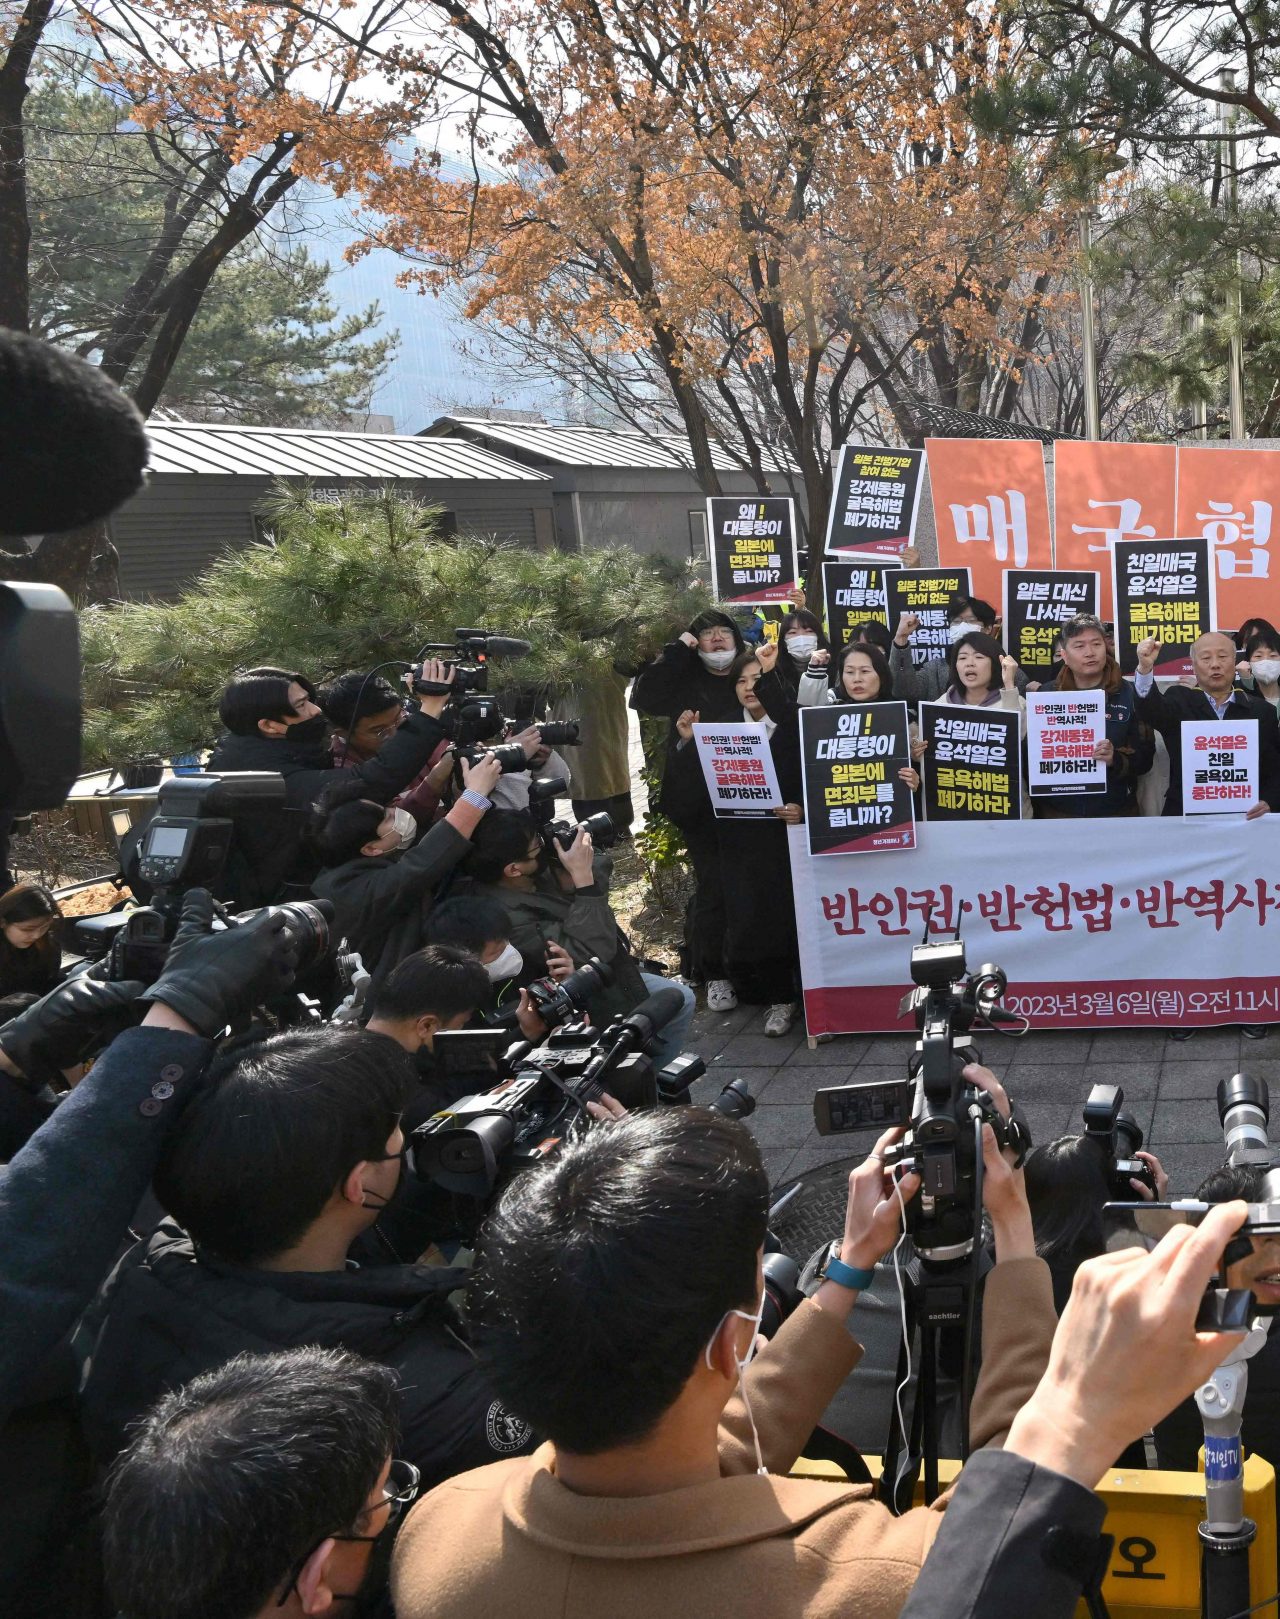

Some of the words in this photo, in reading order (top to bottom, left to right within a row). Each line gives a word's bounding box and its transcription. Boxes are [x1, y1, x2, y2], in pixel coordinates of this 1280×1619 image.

[853, 454, 873, 464] 일본
[874, 455, 911, 467] 전범기업
[860, 465, 880, 476] 참여
[881, 467, 901, 478] 없는
[850, 479, 906, 498] 강제동원
[847, 496, 903, 513] 굴욕해법
[723, 520, 782, 535] 대통령이
[844, 511, 901, 530] 폐기하라
[734, 539, 774, 553] 일본에
[729, 554, 781, 568] 면죄부를
[1127, 552, 1197, 573] 친일매국
[732, 569, 780, 584] 줍니까?
[897, 580, 916, 592] 일본
[918, 579, 959, 591] 전범기업
[1016, 582, 1050, 600] 일본
[1052, 583, 1087, 601] 대신
[1127, 574, 1197, 596] 윤석열은
[907, 593, 927, 605] 참여
[929, 592, 950, 604] 없는
[900, 609, 948, 627] 제동
[1026, 603, 1076, 621] 나서는
[1130, 601, 1200, 622] 굴욕해법
[1130, 624, 1201, 644] 폐기하라
[1035, 704, 1065, 714] 반인권!
[1068, 703, 1098, 713] 반헌법!
[1047, 715, 1086, 725] 반역사적!
[934, 718, 1007, 744] 친일매국
[1041, 729, 1094, 744] 강제동원
[702, 735, 731, 744] 반인권!
[732, 735, 761, 744] 반헌법!
[816, 735, 895, 759] 대통령이
[1194, 735, 1247, 750] 윤석열은
[715, 746, 752, 755] 반역사적!
[934, 741, 1007, 766] 윤석열은
[1041, 744, 1094, 759] 굴욕해법
[712, 759, 764, 772] 강제동원
[1208, 752, 1234, 766] 친일
[831, 762, 885, 784] 일본에
[1039, 760, 1096, 774] 폐기하라!
[716, 773, 767, 786] 굴욕해법
[937, 767, 1009, 793] 굴욕해법
[1194, 769, 1248, 783] 굴욕외교
[717, 787, 773, 799] 폐기하라!
[824, 783, 894, 806] 면죄부를
[1192, 785, 1251, 800] 중단하라!
[937, 789, 1011, 815] 폐기하라
[829, 805, 893, 827] 줍니까?
[1007, 994, 1077, 1017] 2023년
[1080, 992, 1114, 1016] 3월
[1117, 990, 1184, 1018] 6일(월)
[1187, 989, 1231, 1014] 오전
[1235, 987, 1279, 1012] 11시
[928, 1312, 961, 1320] sachtler
